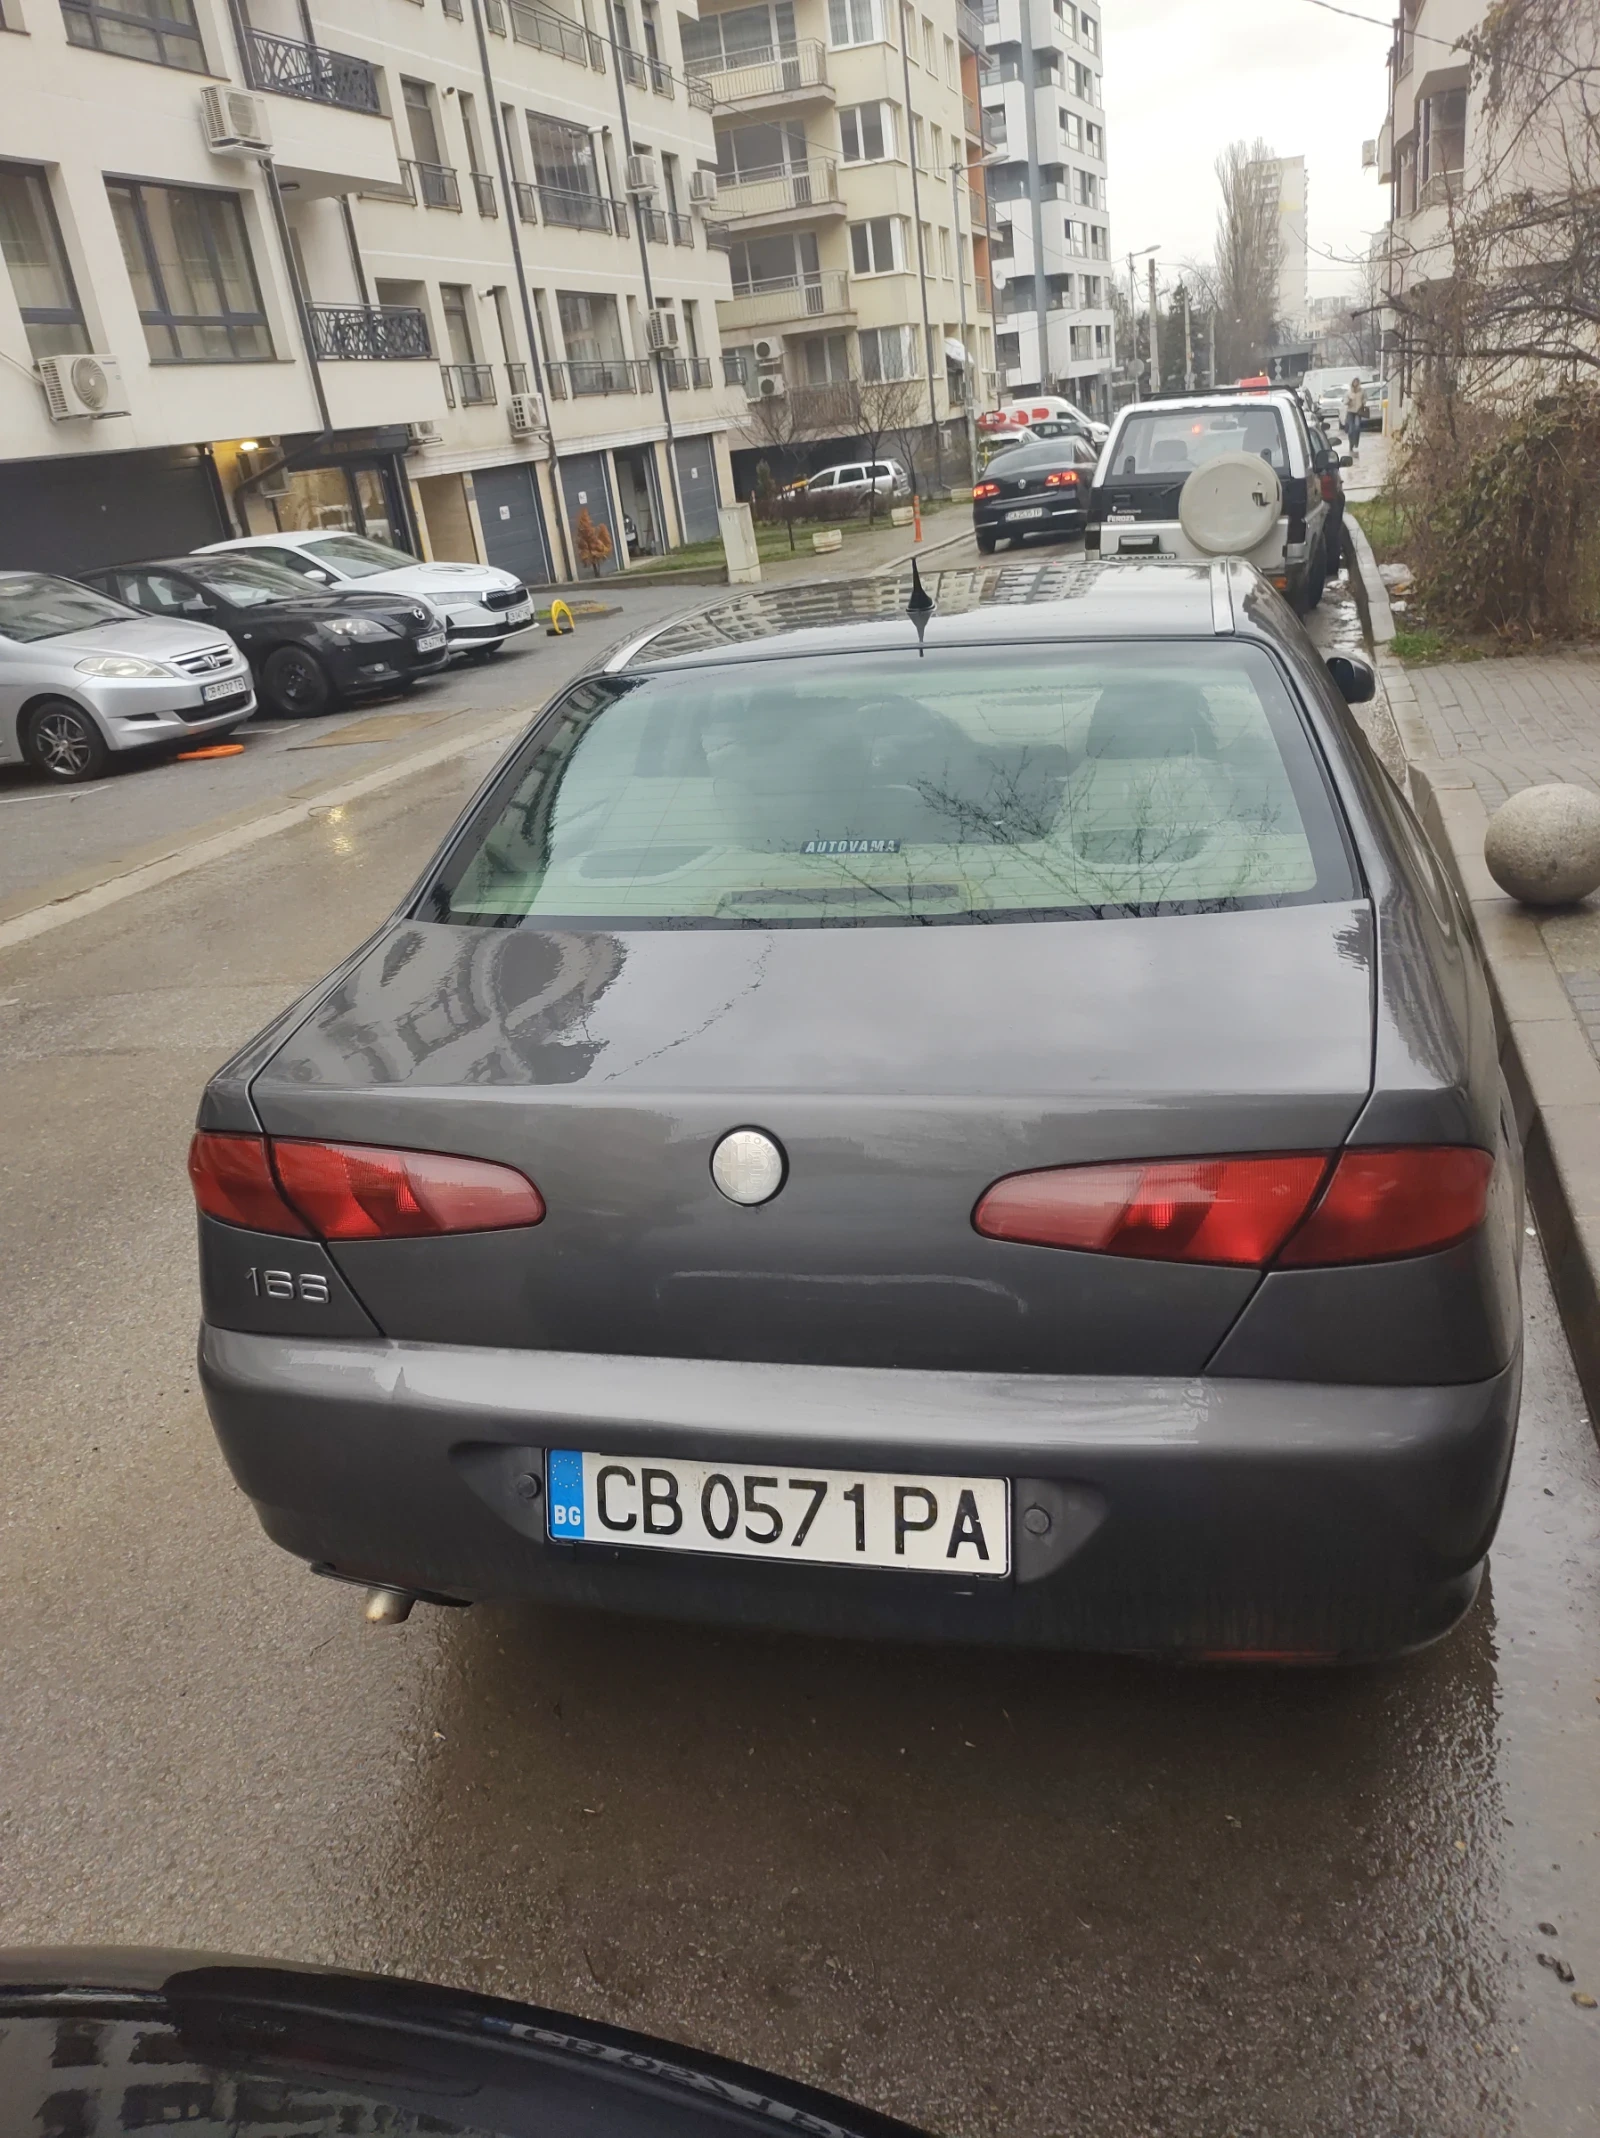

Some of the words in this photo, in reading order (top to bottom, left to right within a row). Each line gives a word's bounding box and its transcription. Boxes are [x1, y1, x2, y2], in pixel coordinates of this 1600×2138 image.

[805, 840, 895, 853] AUTOVAMA
[244, 1267, 329, 1304] 166
[554, 1504, 582, 1527] BG
[596, 1464, 684, 1536] CB
[700, 1473, 868, 1553] 0571
[893, 1485, 991, 1561] PA
